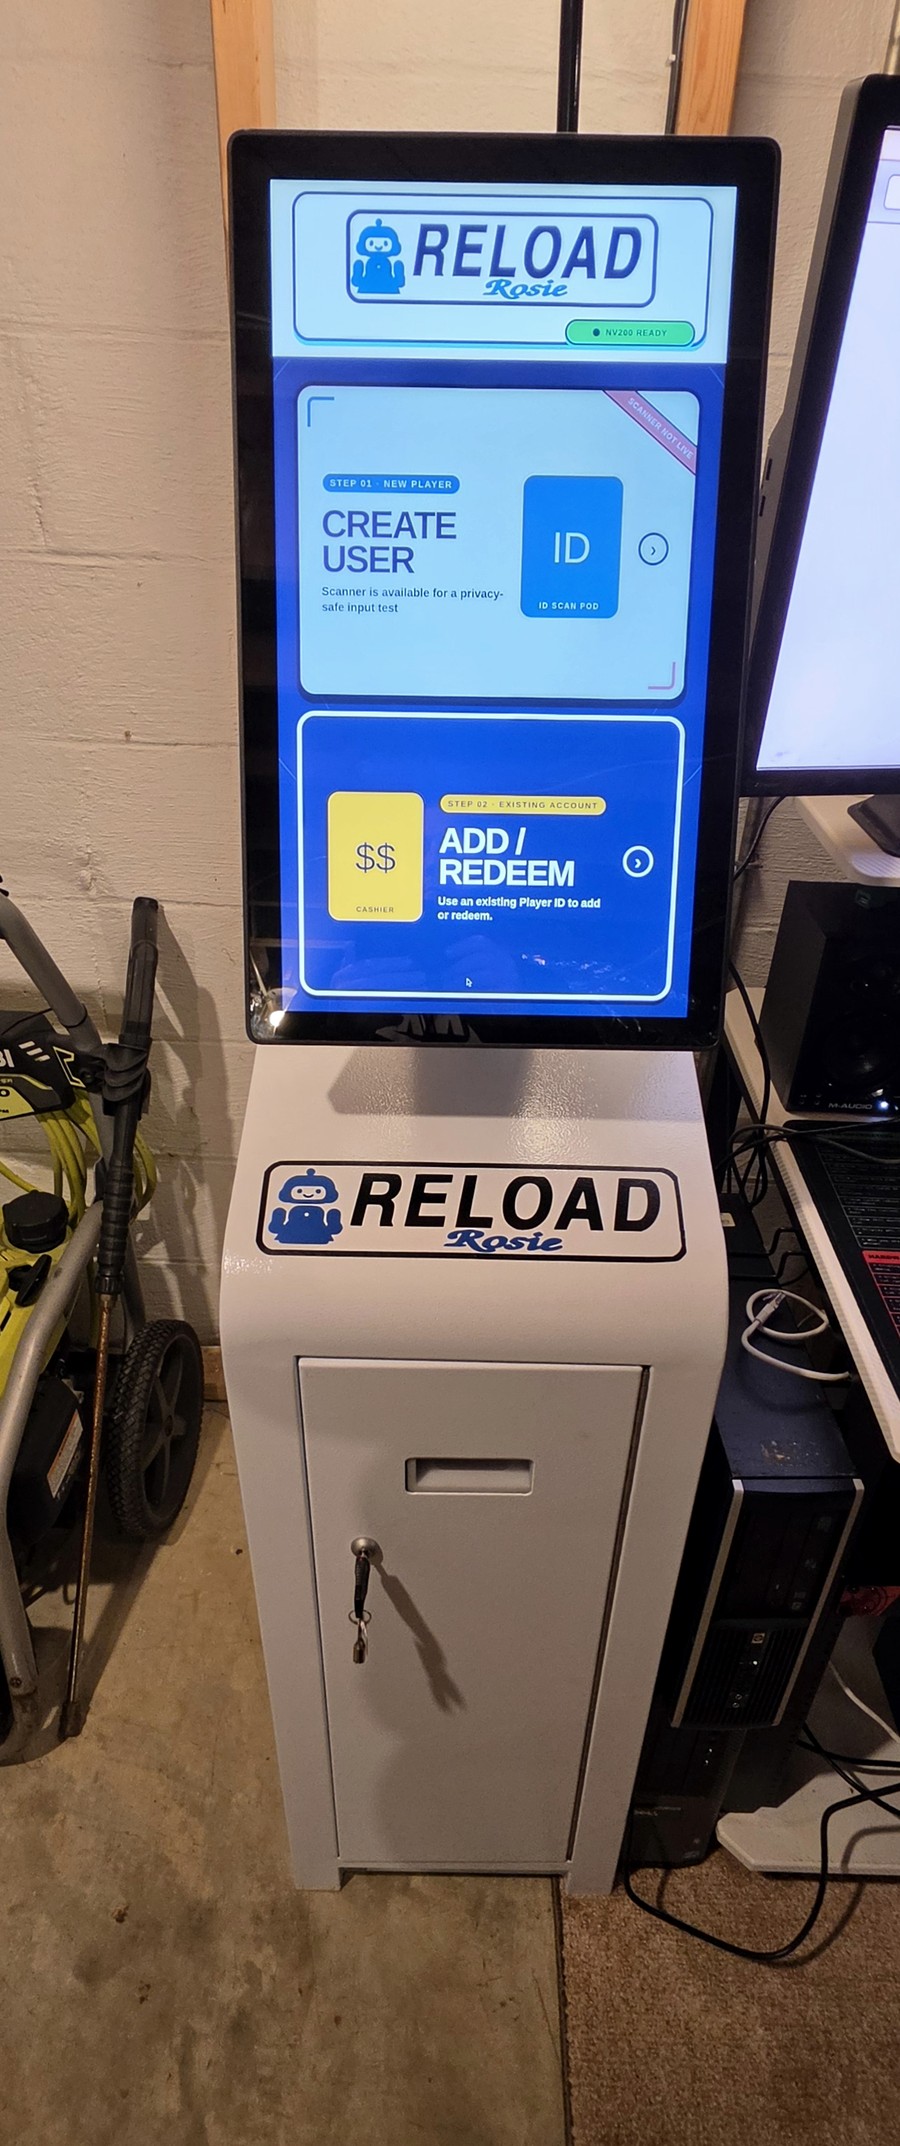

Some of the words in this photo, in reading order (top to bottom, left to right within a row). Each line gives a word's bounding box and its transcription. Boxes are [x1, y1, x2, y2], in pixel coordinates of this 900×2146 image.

[412, 223, 643, 279] RELOAD
[482, 278, 569, 299] Rosie
[605, 327, 634, 337] NV200
[636, 328, 668, 338] READY
[627, 397, 662, 431] SCANNER
[660, 427, 678, 444] NOT
[676, 441, 694, 460] LIVE
[329, 478, 357, 488] STEP
[360, 479, 373, 488] 01
[383, 479, 408, 489] NEW
[410, 480, 453, 489] PLAYER
[321, 509, 458, 540] CREATE
[553, 531, 592, 565] ID
[322, 544, 416, 574] USER
[321, 586, 367, 597] Scanner
[369, 586, 379, 597] is
[381, 587, 430, 598] available
[432, 588, 448, 599] for
[450, 589, 458, 599] a
[460, 588, 504, 601] privacy-
[321, 602, 345, 612] safe
[347, 602, 376, 615] input
[378, 603, 399, 613] test
[538, 601, 549, 610] ID
[551, 602, 576, 610] SCAN
[579, 602, 600, 610] POD
[447, 800, 474, 808] STEP
[476, 801, 488, 809] 02
[499, 801, 546, 809] EXISTING
[549, 801, 598, 810] ACCOUNT
[438, 826, 509, 855] ADD
[514, 826, 527, 856] /
[354, 841, 397, 874] $$
[438, 858, 576, 888] REDEEM
[355, 905, 395, 914] CASHIER
[437, 895, 458, 906] Use
[460, 897, 474, 907] an
[475, 896, 517, 909] existing
[519, 896, 552, 910] Player
[553, 897, 566, 908] ID
[567, 898, 579, 908] to
[580, 898, 601, 909] add
[437, 911, 450, 921] or
[451, 910, 493, 921] redeem.
[828, 1102, 873, 1110] M-AUDIO
[349, 1172, 661, 1232] RELOAD
[443, 1228, 563, 1253] Rosie
